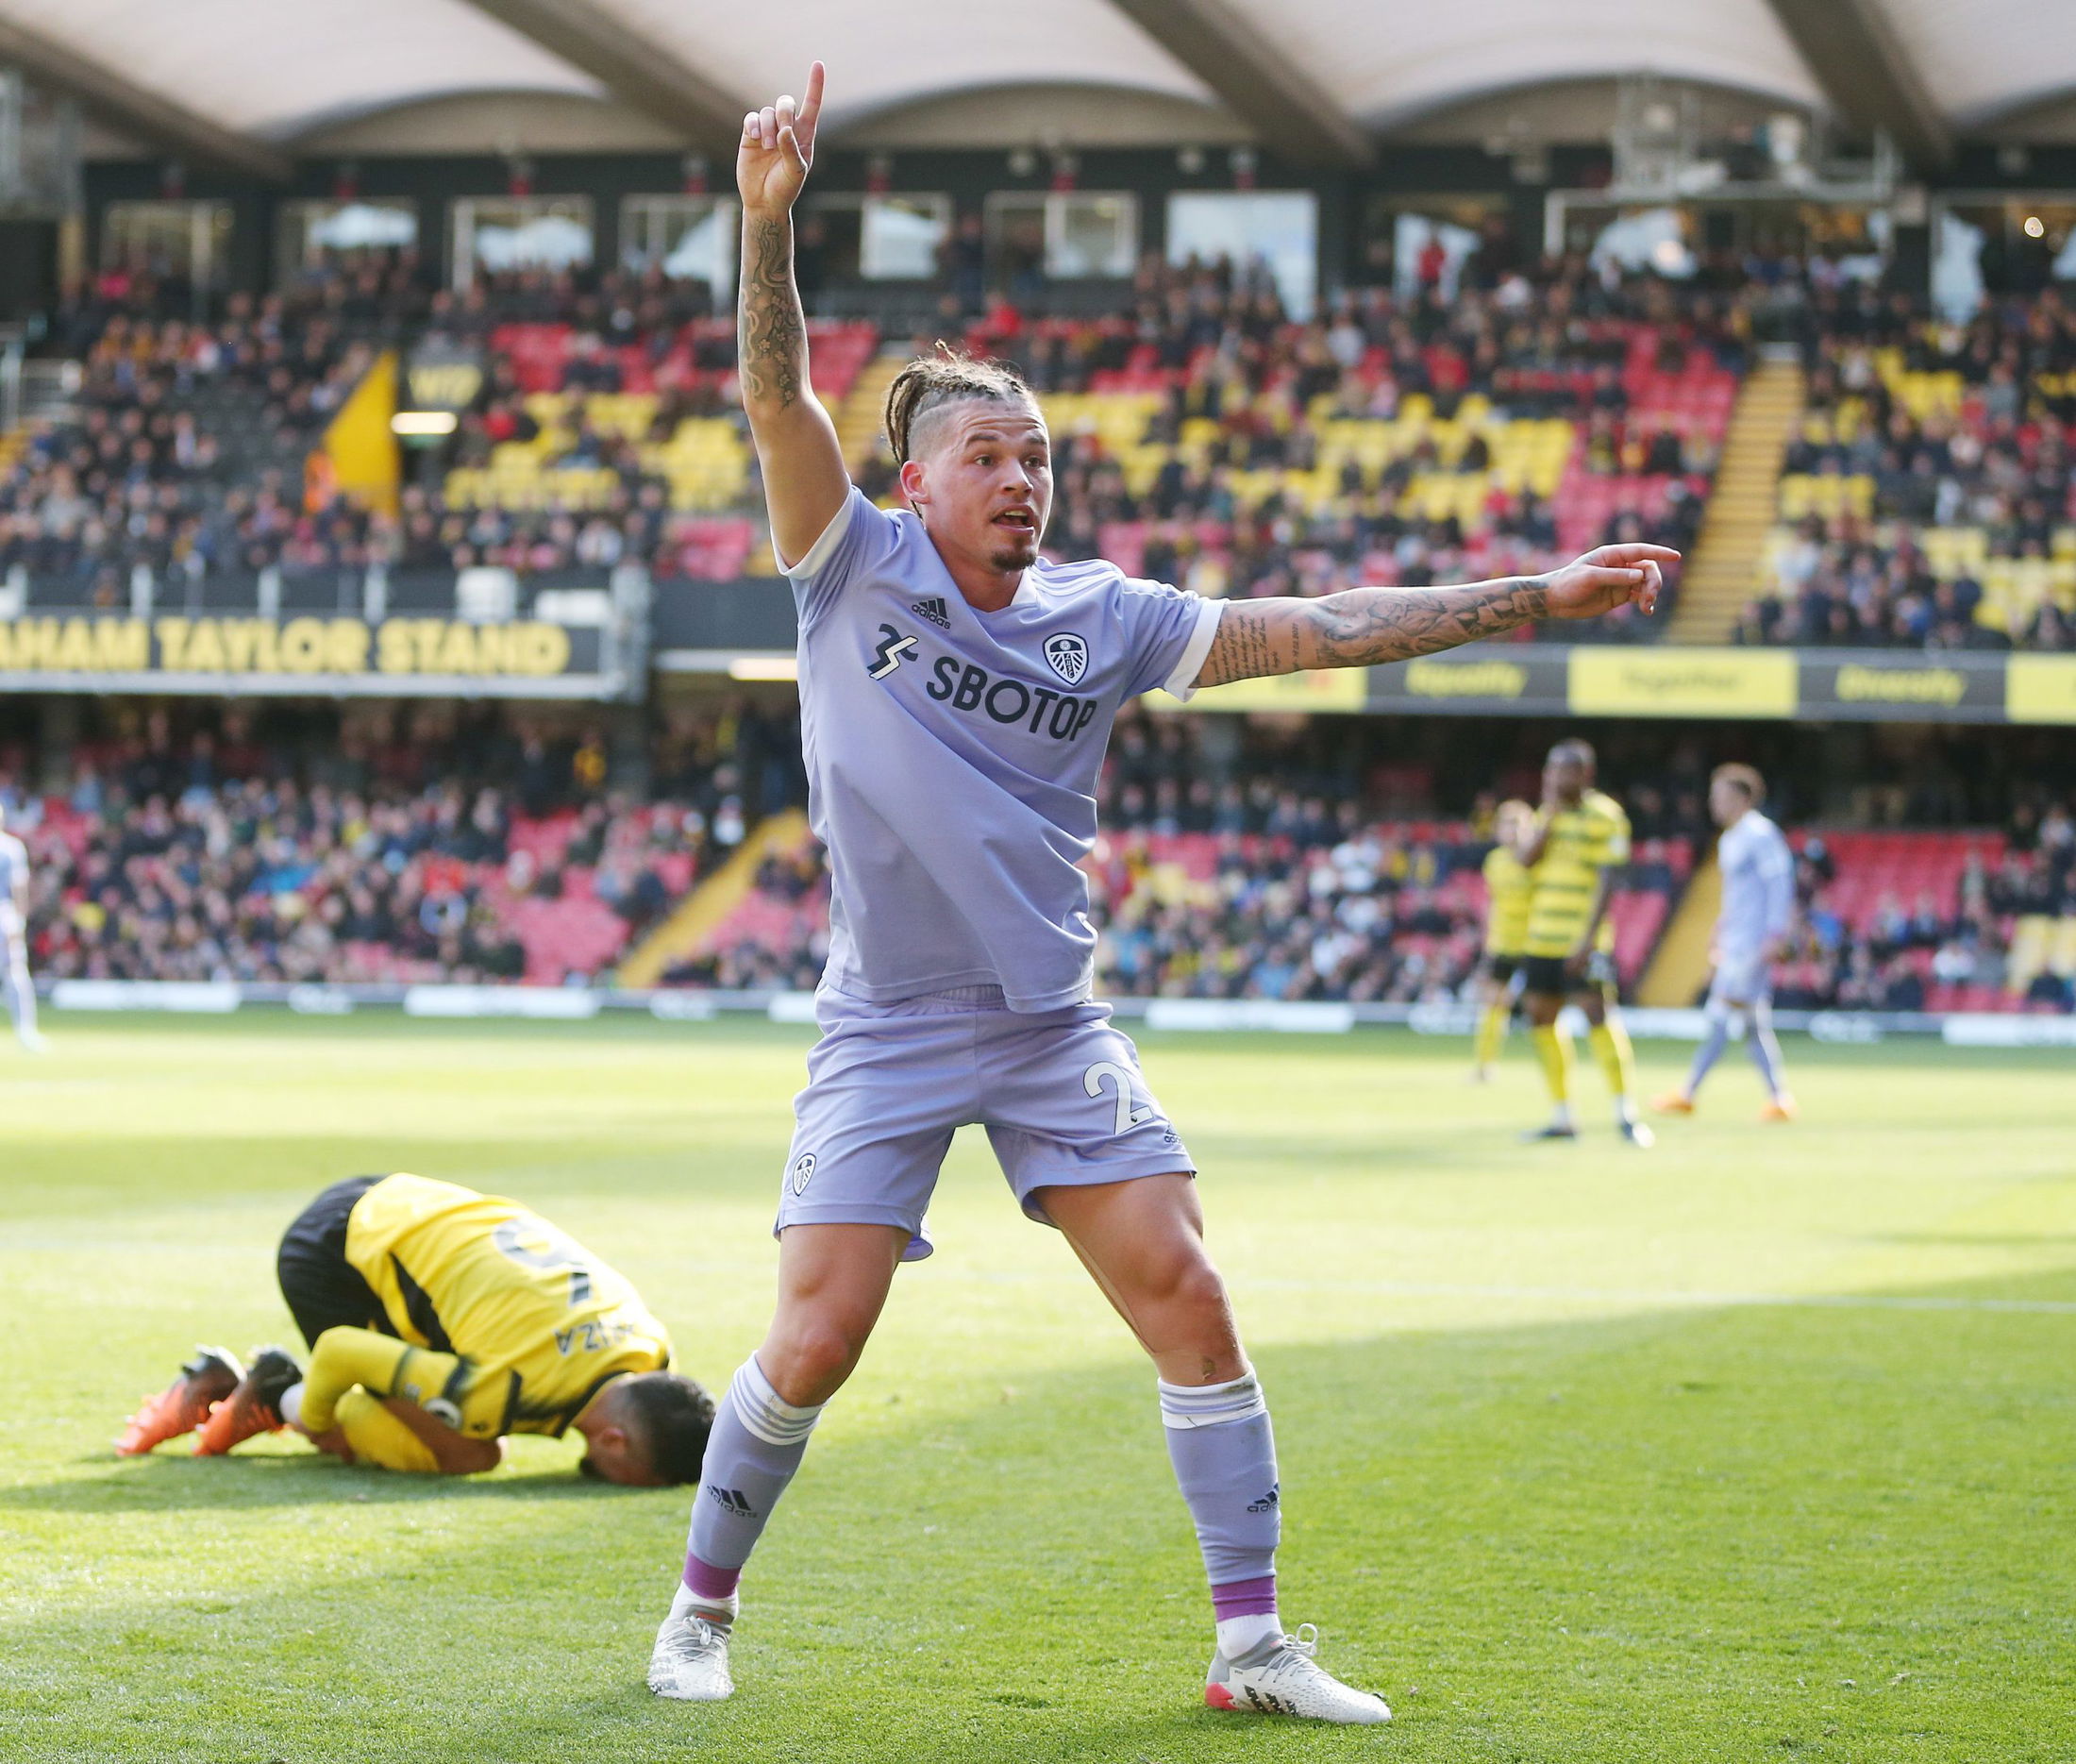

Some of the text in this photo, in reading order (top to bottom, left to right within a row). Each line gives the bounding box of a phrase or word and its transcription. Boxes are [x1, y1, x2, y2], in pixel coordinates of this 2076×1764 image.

[911, 602, 951, 630] adidas
[155, 616, 370, 675] TAYLOR
[377, 618, 571, 677] STAND
[926, 656, 1097, 742] SBOTOP
[707, 1485, 758, 1519] adidas
